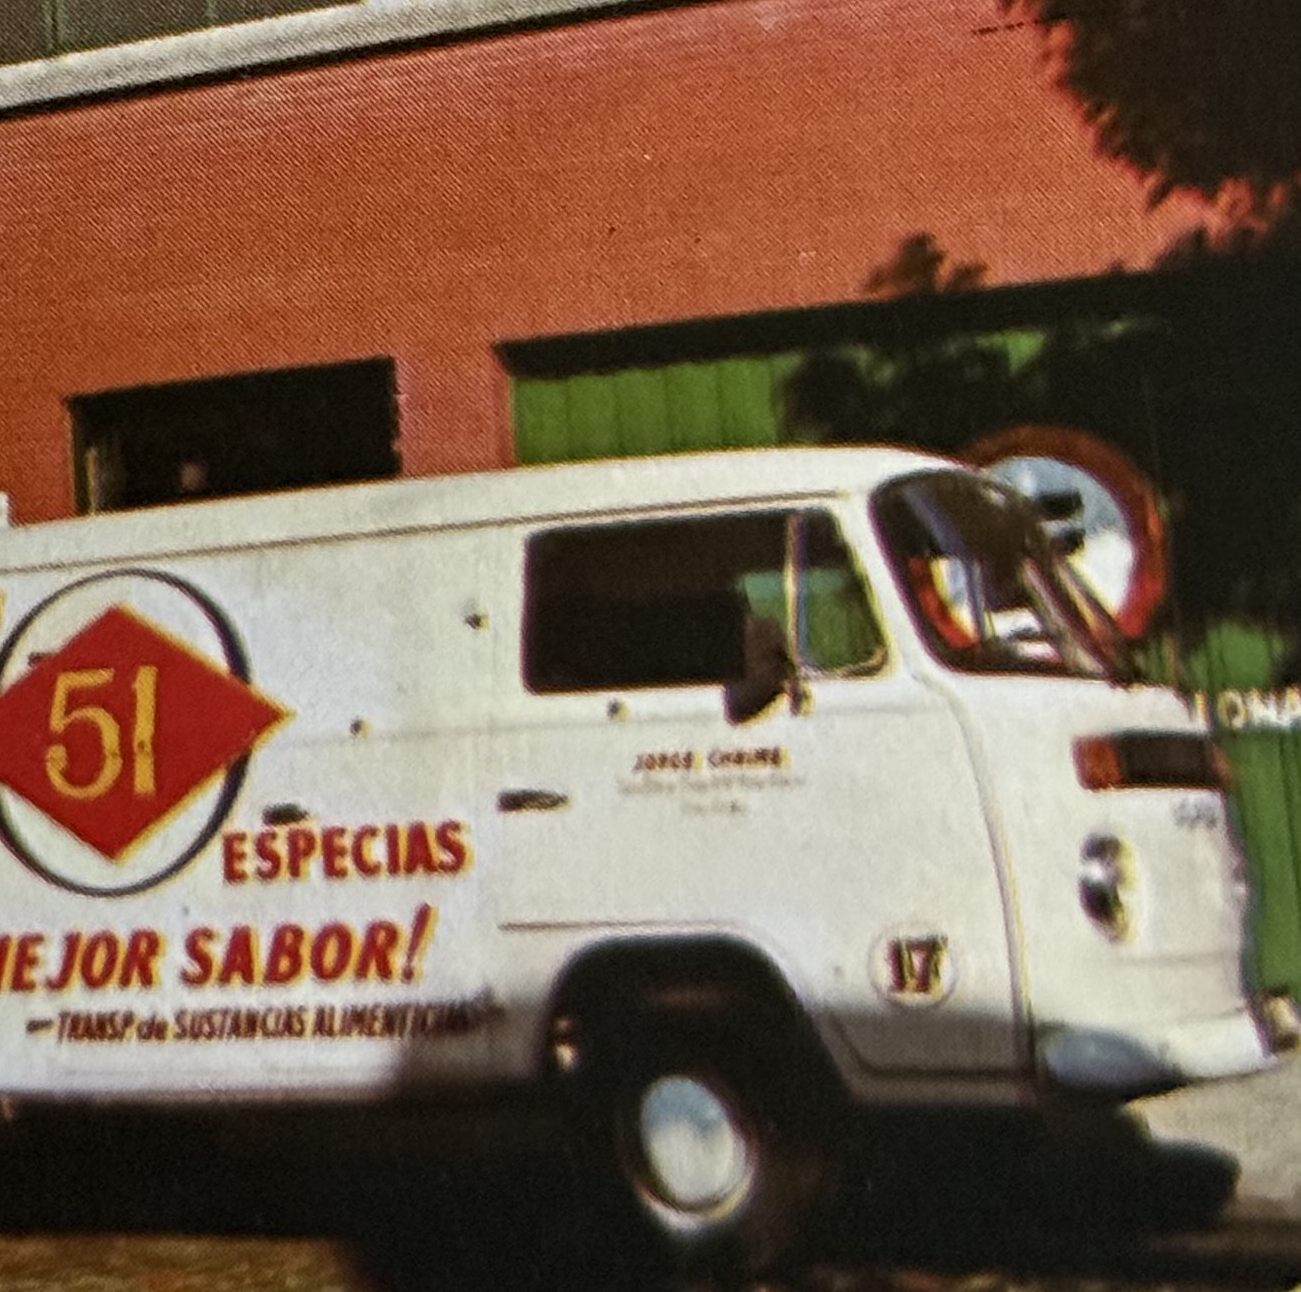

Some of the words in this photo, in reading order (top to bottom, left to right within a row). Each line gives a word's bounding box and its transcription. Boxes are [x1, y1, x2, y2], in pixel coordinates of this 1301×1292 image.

[44, 665, 159, 800] 51
[222, 821, 471, 884] ESPECIAS
[179, 903, 438, 986] SABOR!
[173, 1004, 307, 1042] SUSTANCIAS
